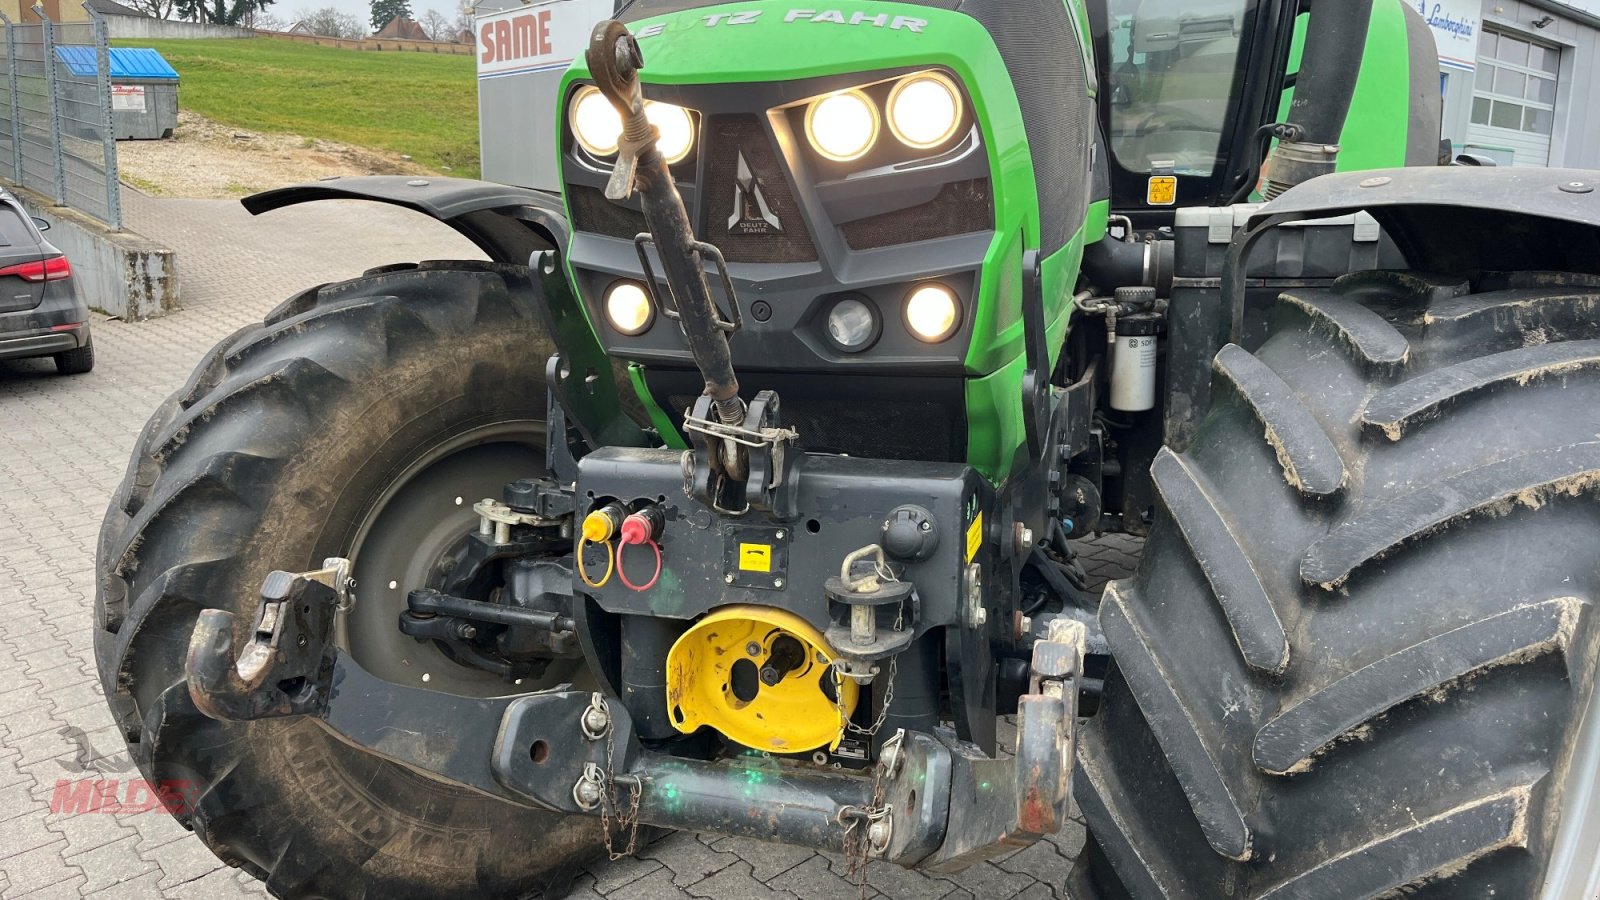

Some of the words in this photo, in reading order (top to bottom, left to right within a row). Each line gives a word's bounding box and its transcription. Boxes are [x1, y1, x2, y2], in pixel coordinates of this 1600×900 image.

[480, 9, 553, 65] SAME
[783, 9, 928, 34] FAHR
[1425, 3, 1473, 39] Lamborghini
